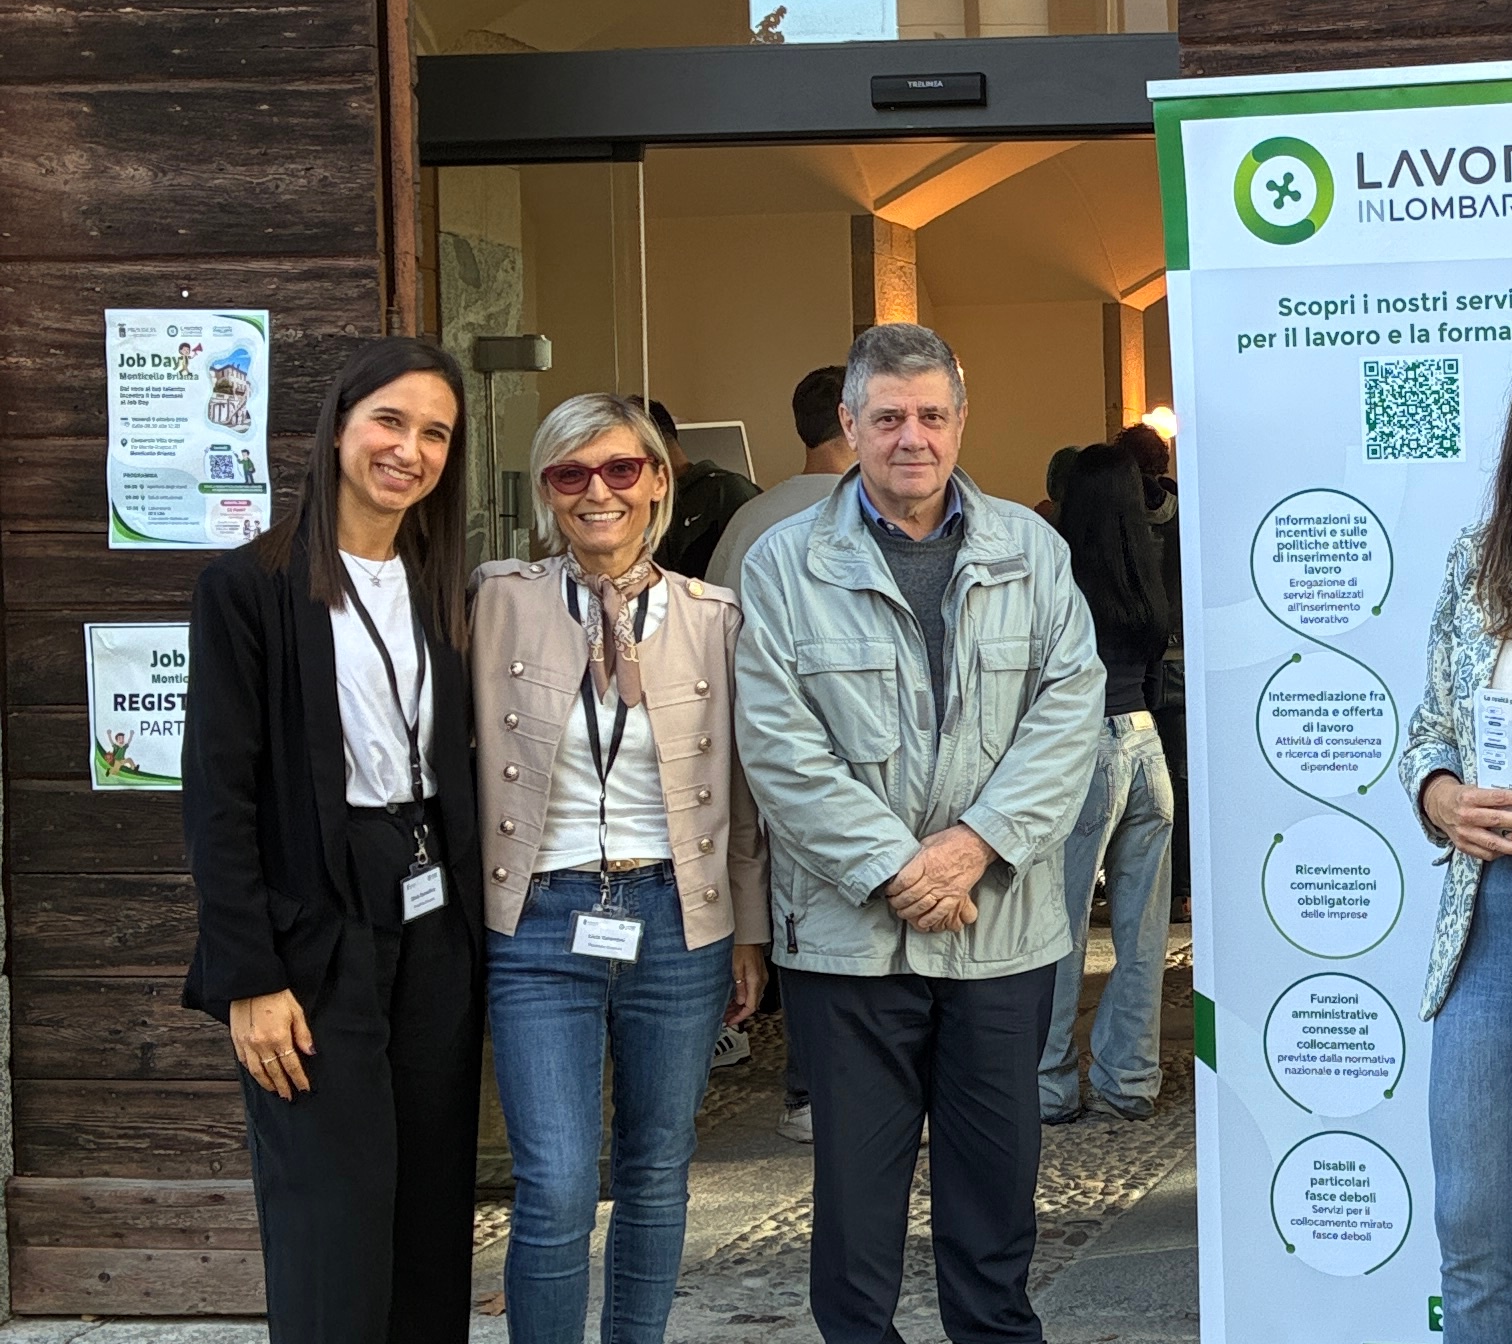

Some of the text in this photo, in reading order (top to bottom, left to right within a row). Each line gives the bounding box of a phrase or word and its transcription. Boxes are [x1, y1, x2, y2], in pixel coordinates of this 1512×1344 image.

[1278, 294, 1355, 320] Scopri
[1363, 293, 1368, 314] i
[1377, 291, 1448, 313] nostri
[1238, 332, 1277, 354] per
[1284, 327, 1297, 347] il
[1305, 327, 1380, 347] lavoro
[1388, 329, 1402, 344] e
[1410, 323, 1430, 343] la
[119, 353, 183, 370] Job Day
[1275, 514, 1366, 526] Informazioni su
[1275, 527, 1367, 538] incentivi e sulle
[1277, 540, 1367, 552] politiche attive
[1273, 551, 1371, 563] di inserimento al
[1305, 564, 1341, 574] lavoro
[1290, 577, 1357, 589] Erogazione di
[1283, 589, 1364, 599] servizi finalizzati
[1300, 615, 1349, 624] lavorativo
[150, 650, 185, 667] Job
[1269, 691, 1385, 702] Intermediazione fra
[1272, 707, 1329, 717] domanda
[1343, 707, 1383, 716] offerta
[1303, 722, 1354, 732] di lavoro
[1275, 736, 1381, 745] Attività di consulenza
[1285, 750, 1318, 758] ricerca
[1321, 749, 1330, 758] di
[1333, 749, 1381, 760] personale
[1301, 762, 1358, 773] dipendente
[1296, 864, 1370, 875] Ricevimento
[1290, 879, 1376, 890] comunicazioni
[1298, 895, 1370, 908] obbligatorie
[1301, 909, 1368, 920] delle imprese
[1310, 993, 1358, 1004] Funzioni
[1292, 1009, 1378, 1020] amministrative
[1302, 1025, 1368, 1035] connesse al
[1297, 1040, 1375, 1050] collocamento
[1278, 1054, 1395, 1064] previste dalla normativa
[1285, 1066, 1331, 1075] nazionale
[1343, 1067, 1388, 1078] regionale
[1313, 1160, 1366, 1172] Disabili e
[1310, 1177, 1369, 1188] particolari
[1305, 1191, 1376, 1203] fasce deboli
[1312, 1205, 1370, 1216] Servizi per il
[1290, 1217, 1393, 1229] collocamento mirato
[1312, 1230, 1371, 1241] fasce deboli
